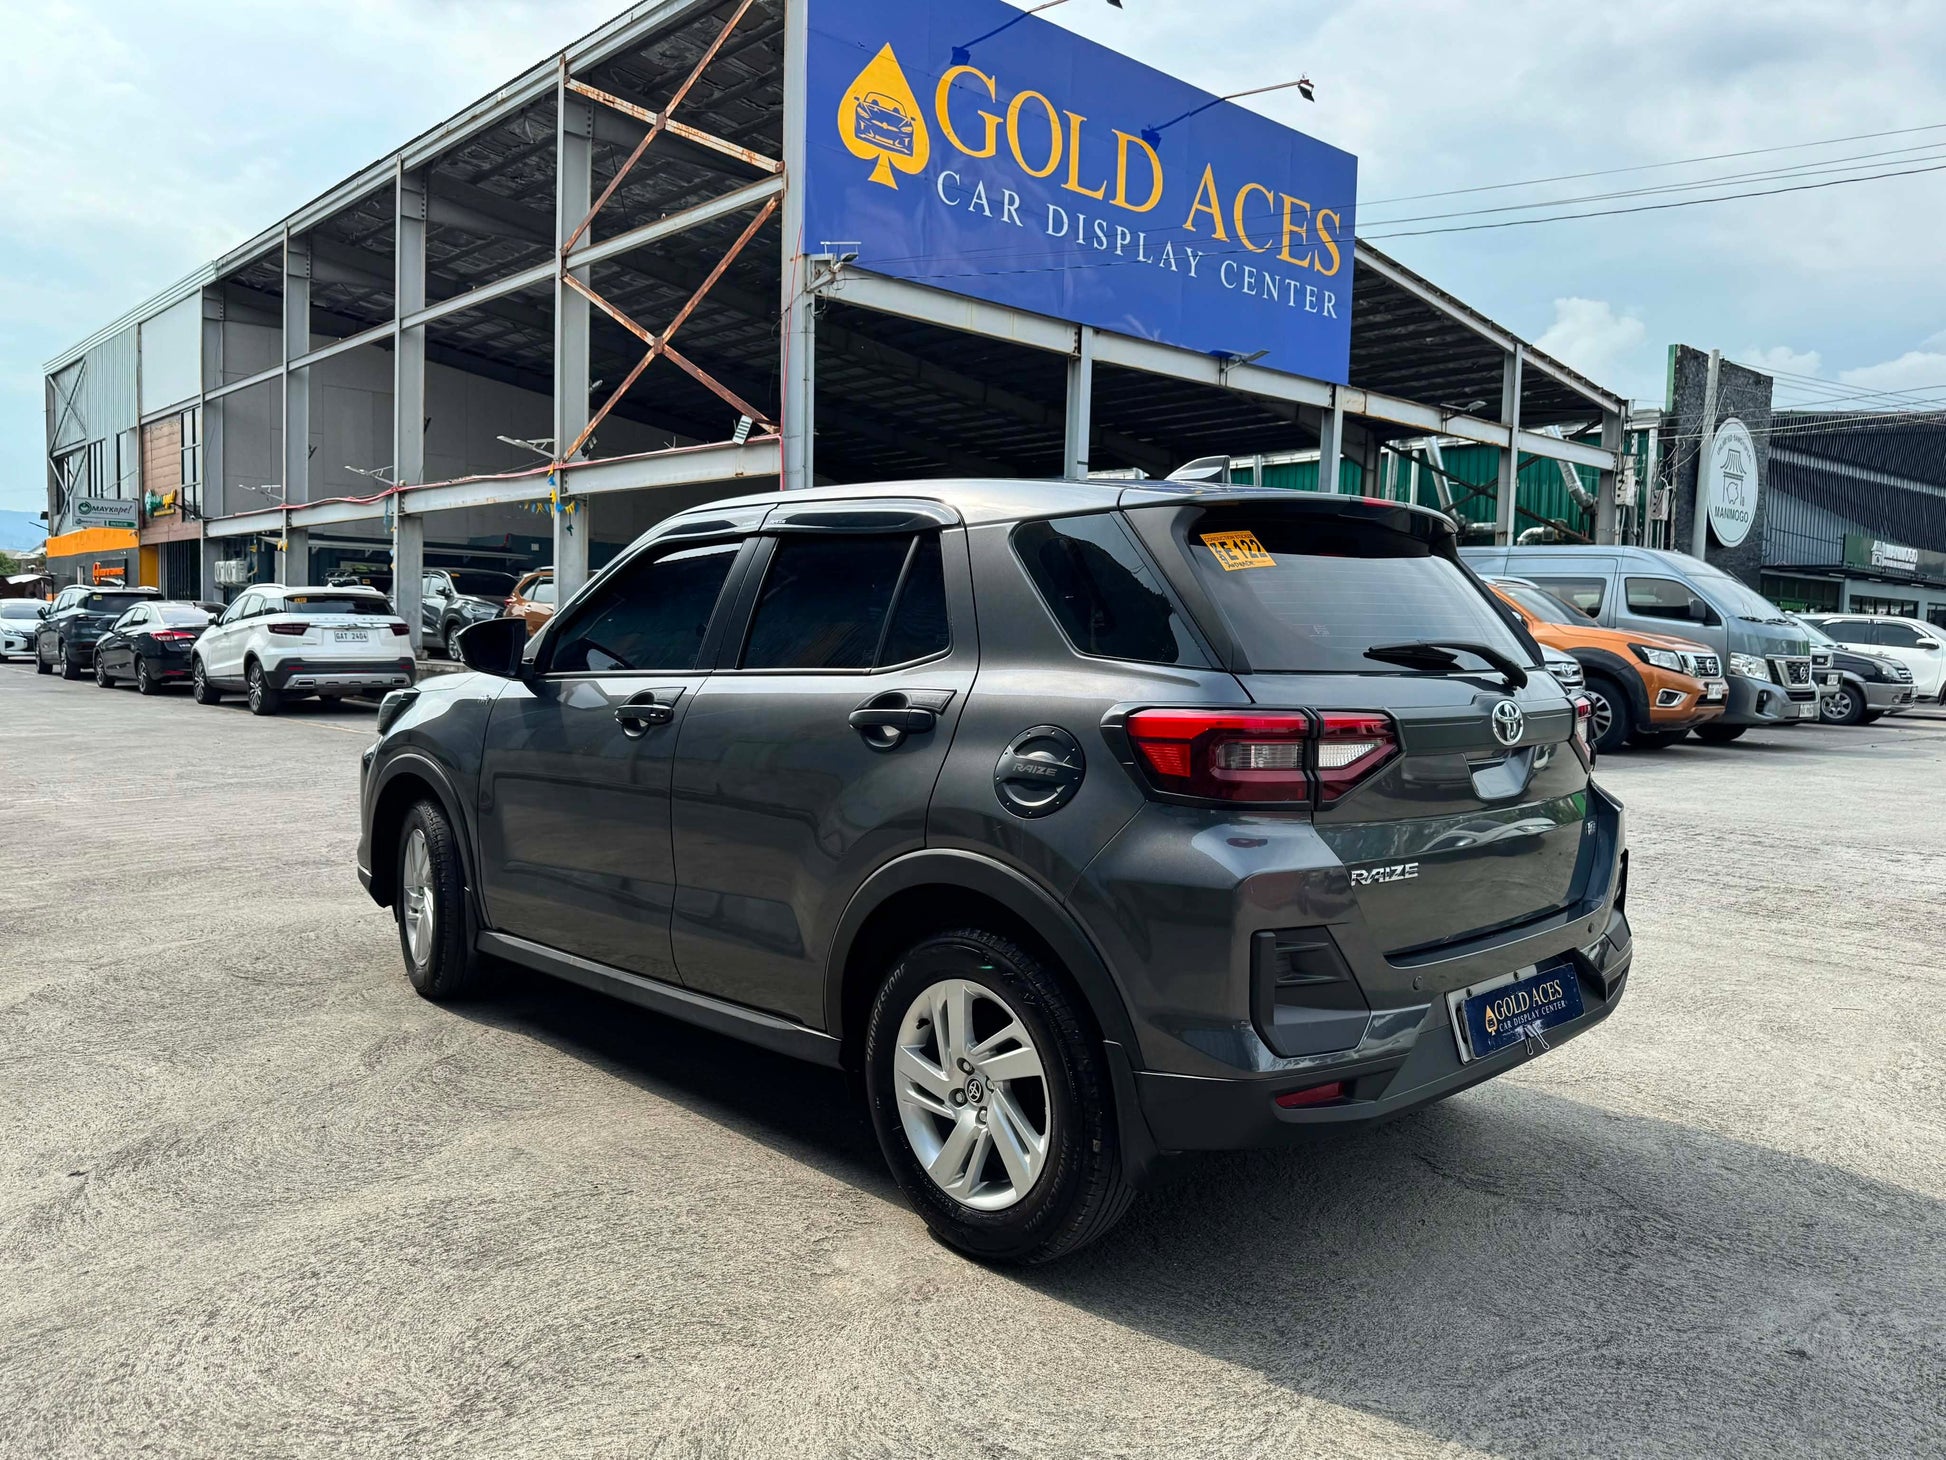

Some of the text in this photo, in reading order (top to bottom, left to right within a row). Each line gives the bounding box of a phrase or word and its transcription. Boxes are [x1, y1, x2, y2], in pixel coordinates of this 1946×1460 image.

[935, 65, 1342, 277] GOLD ACES
[936, 170, 1338, 319] CAR DISPLAY CENTER
[1012, 762, 1059, 777] RAIZE
[1350, 862, 1419, 887] RAIZE
[1494, 979, 1563, 1020] GOLD ACES
[1499, 1000, 1566, 1032] CAR DISPLAY CENTER
